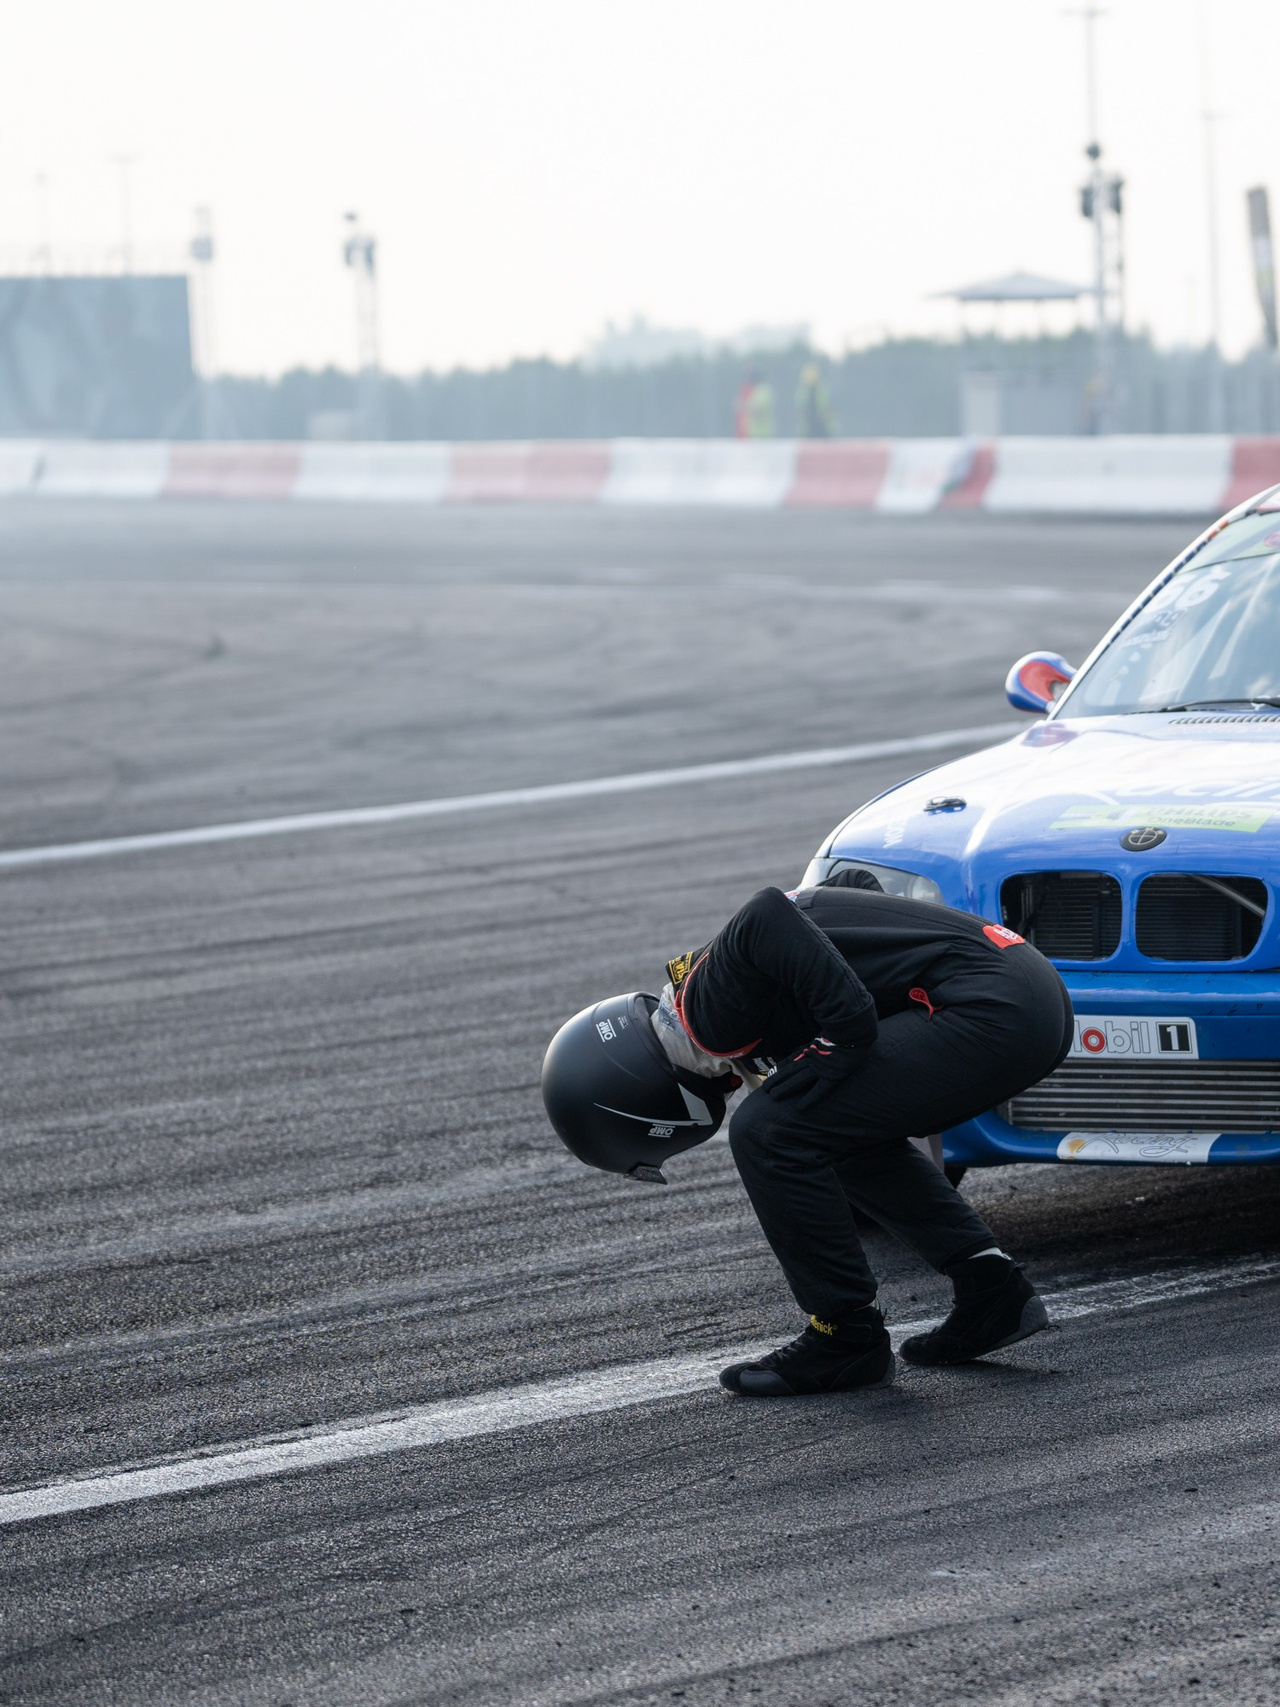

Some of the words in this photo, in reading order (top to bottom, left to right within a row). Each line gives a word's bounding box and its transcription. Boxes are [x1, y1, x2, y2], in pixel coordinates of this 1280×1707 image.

[1145, 806, 1252, 820] PHILIPS
[1147, 815, 1236, 828] OneBlade
[598, 1021, 613, 1041] OMP
[649, 1126, 674, 1136] OMP
